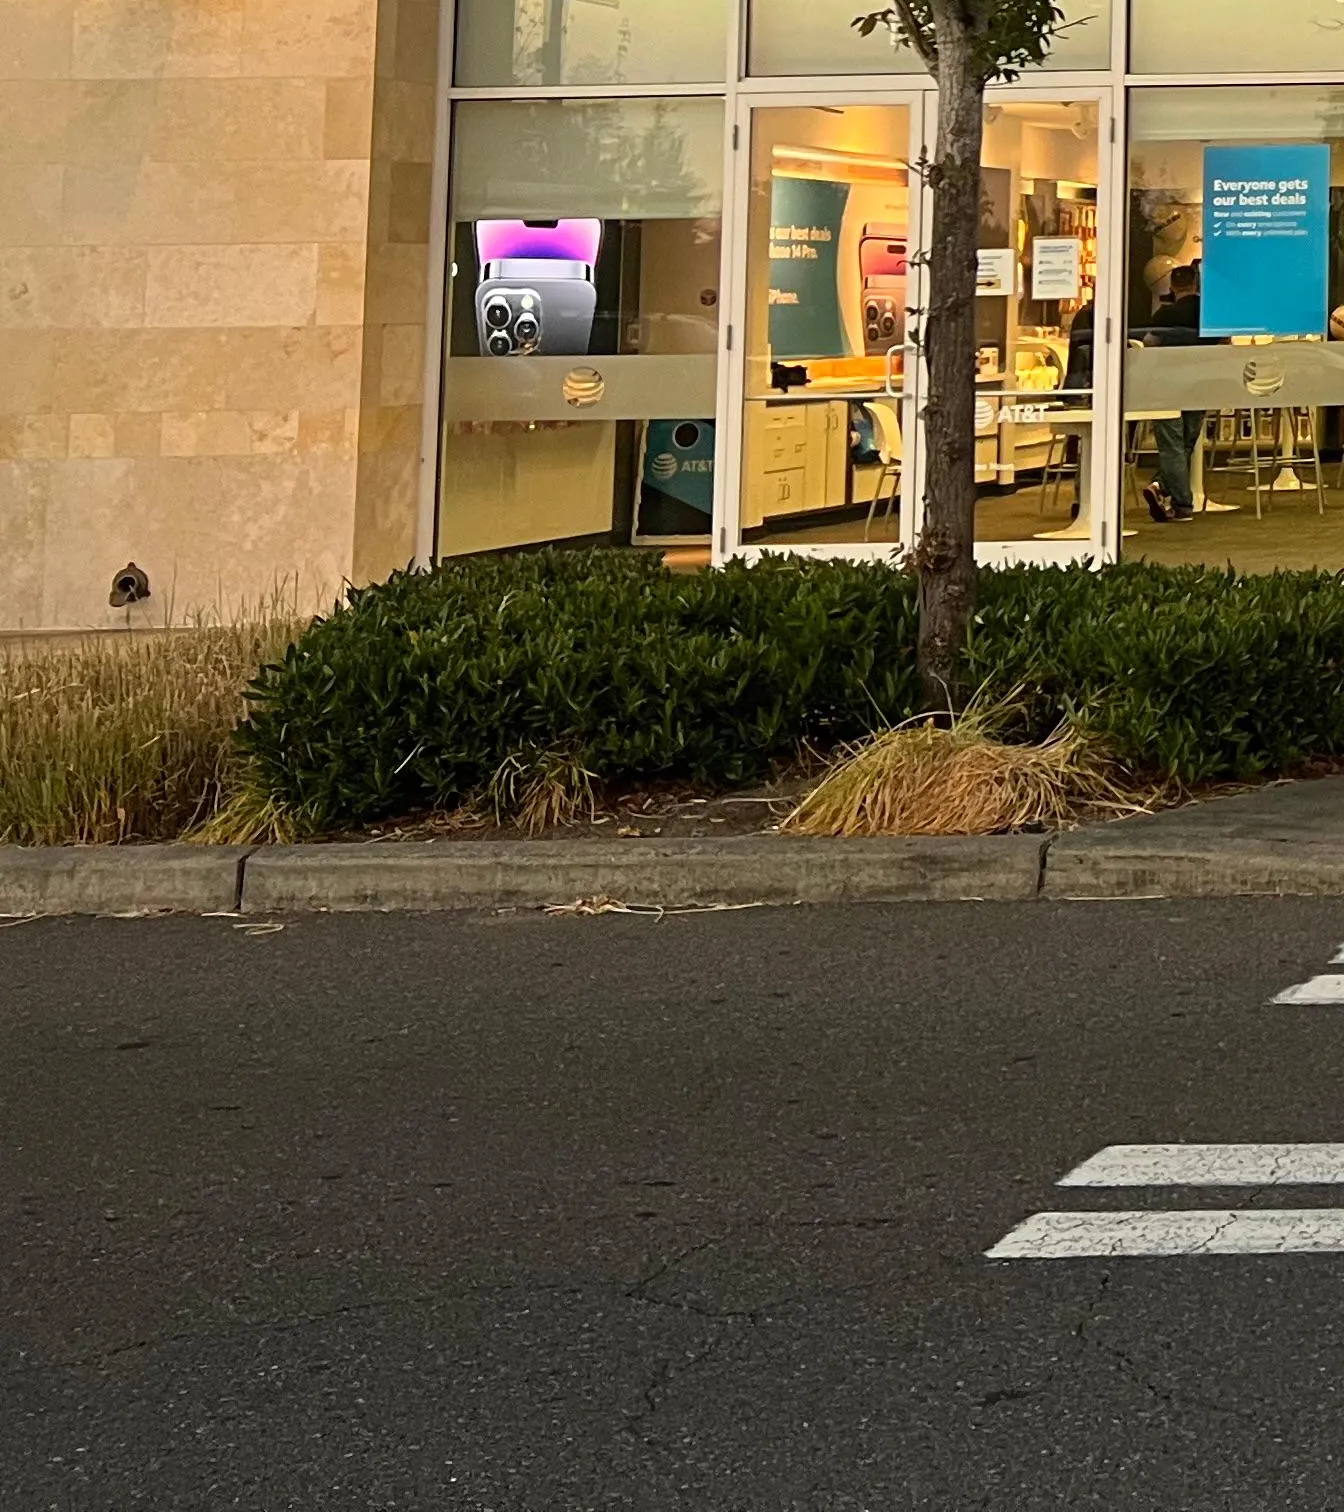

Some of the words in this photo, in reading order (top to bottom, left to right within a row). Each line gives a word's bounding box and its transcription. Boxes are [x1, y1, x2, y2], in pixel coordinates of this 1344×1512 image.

[1213, 179, 1276, 194] Everyone
[1278, 178, 1309, 193] gets
[1213, 196, 1237, 206] our
[1239, 193, 1269, 206] best
[1271, 192, 1307, 205] deals
[997, 403, 1050, 424] AT&T
[681, 458, 714, 473] AT&T
